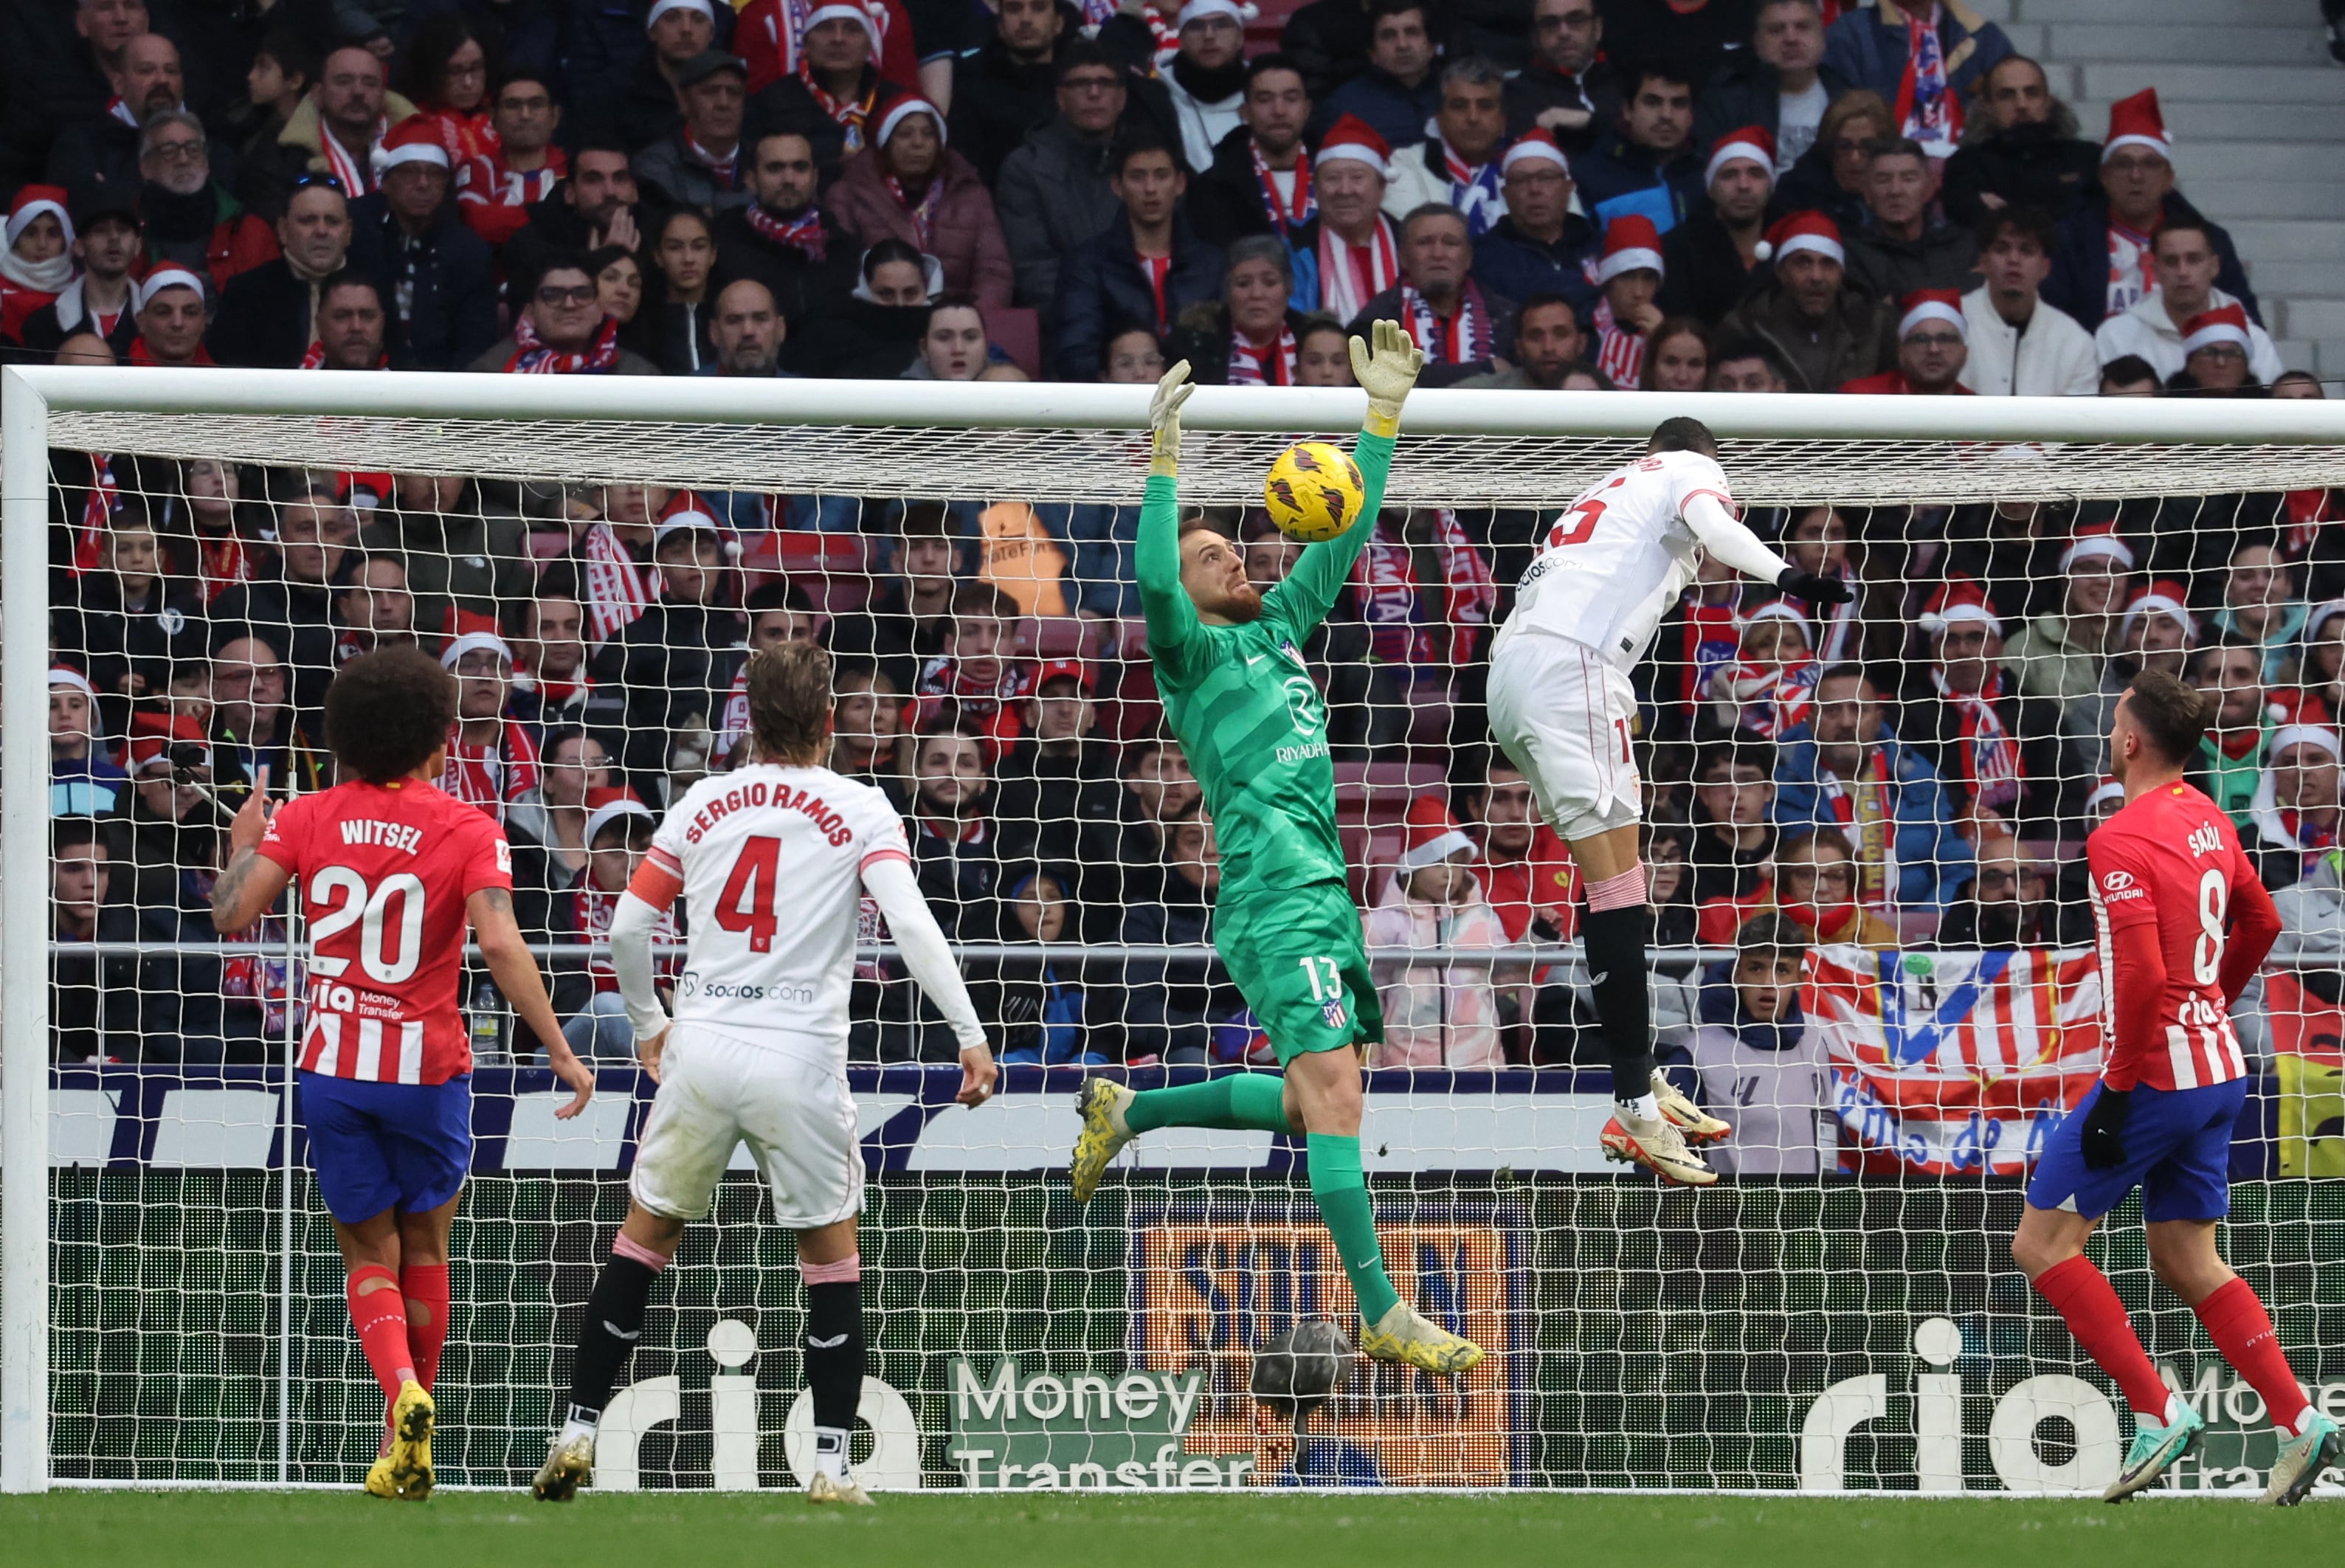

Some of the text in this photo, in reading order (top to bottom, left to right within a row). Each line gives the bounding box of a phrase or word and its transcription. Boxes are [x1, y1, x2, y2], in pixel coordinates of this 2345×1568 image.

[340, 819, 423, 855] WITSEL
[686, 783, 852, 847] SERGIO RAMOS
[2188, 821, 2224, 858] SAÚL
[715, 835, 781, 953] 4
[2104, 888, 2144, 905] HYUNDAI
[309, 866, 425, 984] 20
[2194, 868, 2225, 985] 8
[360, 990, 401, 1006] Money
[1299, 956, 1341, 1001] 13
[358, 1004, 405, 1020] Transfer
[957, 1363, 1201, 1434] Money
[1801, 1317, 2121, 1491] ria
